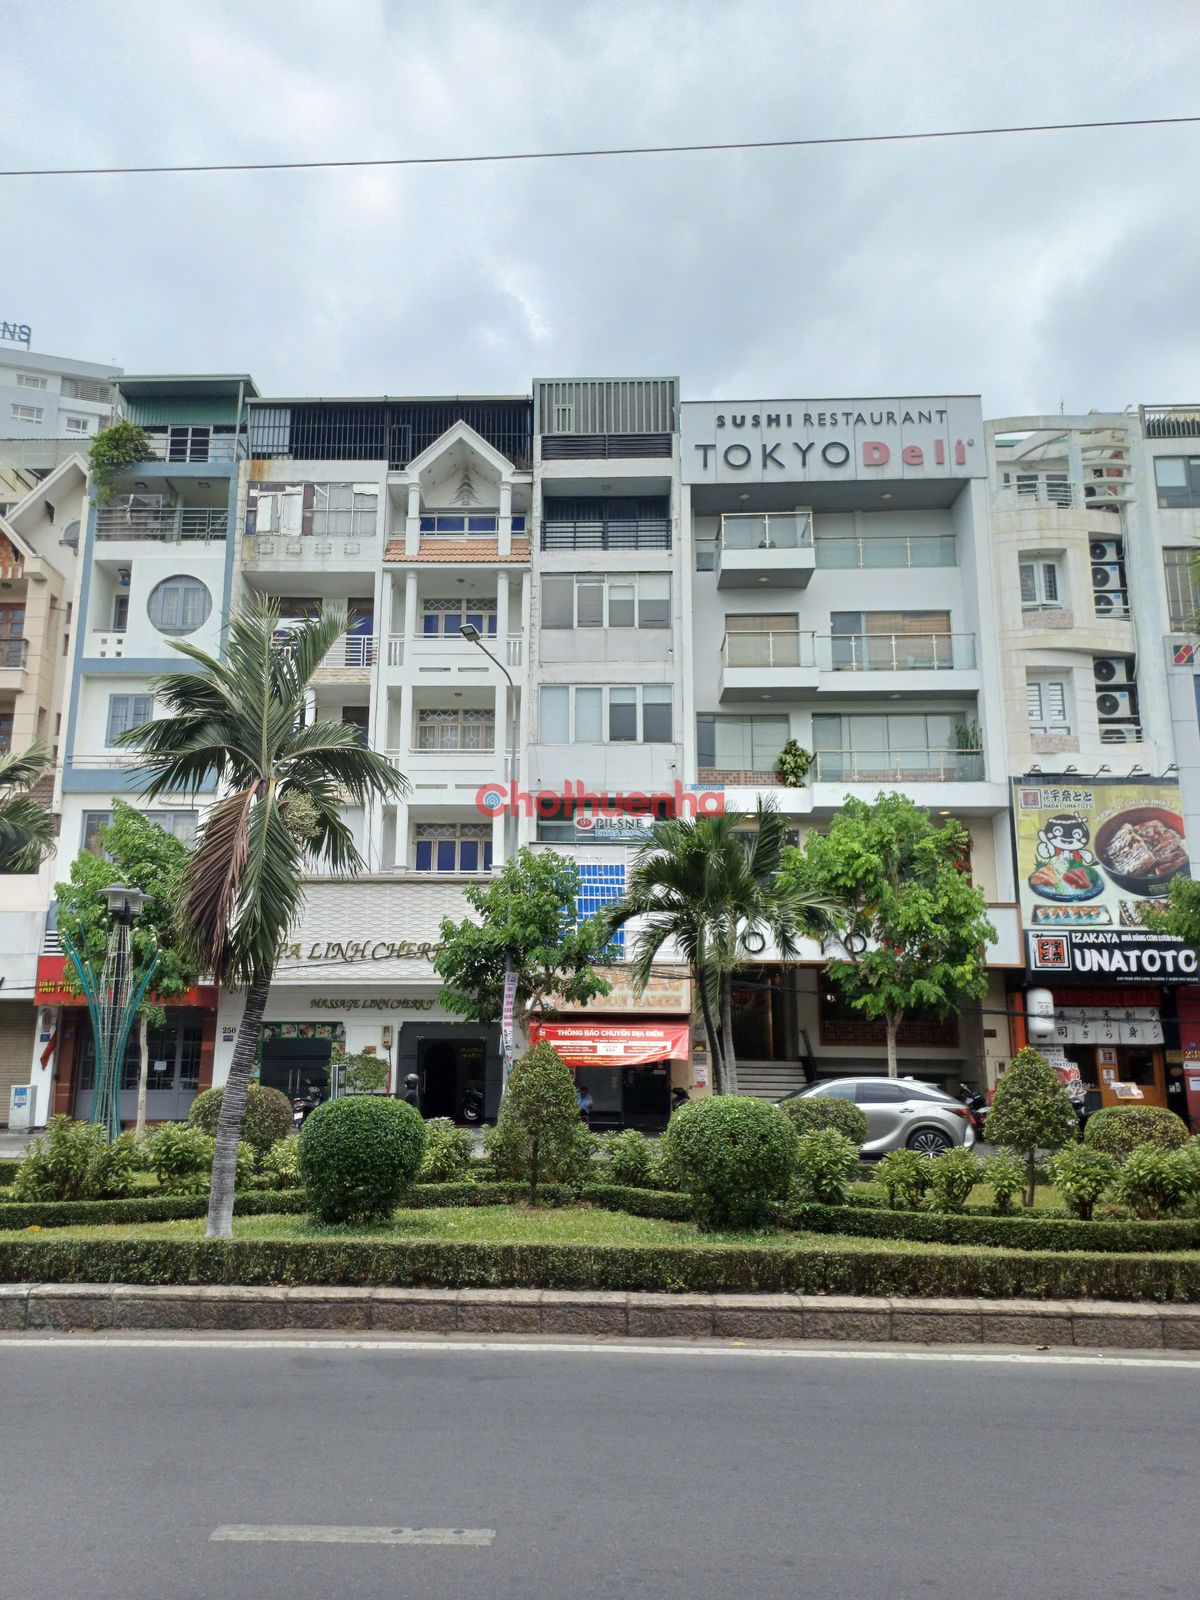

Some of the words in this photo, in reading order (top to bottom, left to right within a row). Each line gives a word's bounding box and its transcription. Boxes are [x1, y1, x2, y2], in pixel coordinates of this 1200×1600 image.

[716, 413, 792, 429] SUSHI
[803, 409, 948, 426] RESTAURANT
[694, 441, 850, 470] TOKYO
[1071, 932, 1120, 944] IZAKAYA
[274, 941, 302, 960] PA
[307, 940, 371, 962] LINH
[372, 940, 448, 962] CHERR
[1074, 948, 1198, 972] UNATOTO
[310, 998, 360, 1011] MASSAGE
[361, 998, 391, 1010] LINH
[390, 998, 435, 1010] CHERRY
[222, 1026, 237, 1034] 250
[557, 1028, 583, 1036] THÔNG
[583, 1028, 600, 1036] BÁO
